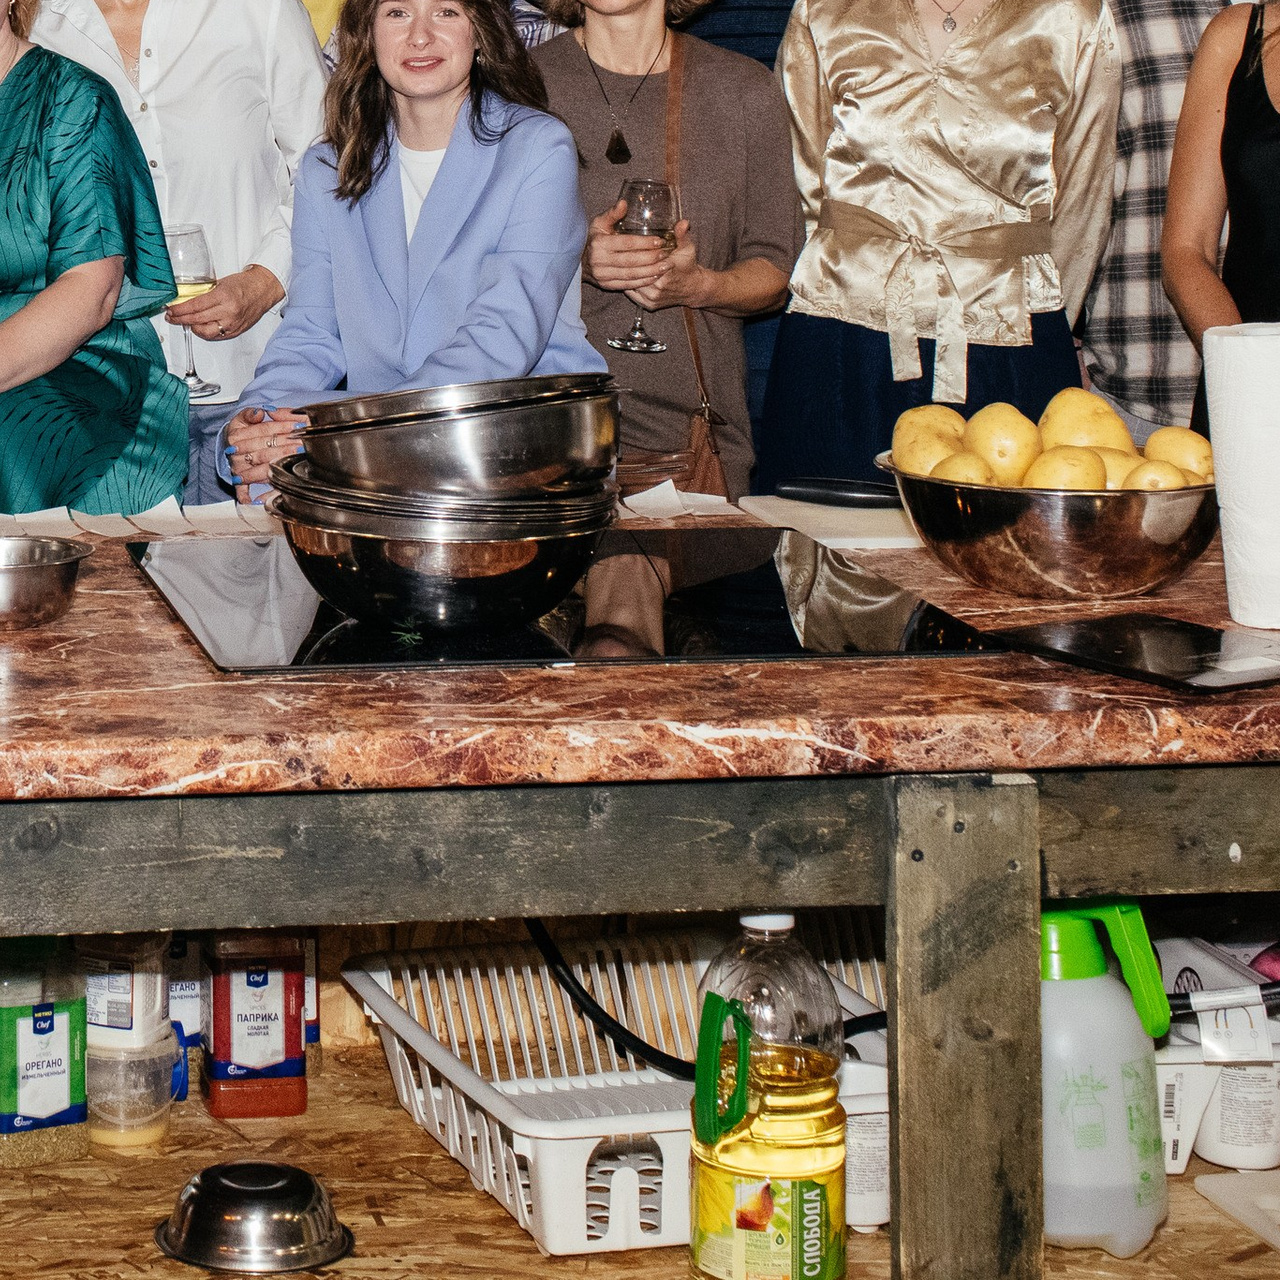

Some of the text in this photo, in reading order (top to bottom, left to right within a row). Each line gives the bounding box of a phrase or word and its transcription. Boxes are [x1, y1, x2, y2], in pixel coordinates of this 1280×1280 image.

[169, 982, 196, 992] ЕГАНО
[236, 1012, 279, 1023] ПАПРИКА
[36, 1019, 51, 1029] Chef
[25, 1058, 63, 1072] ОРЕГАНО
[802, 1188, 821, 1278] СЛОБОДА
